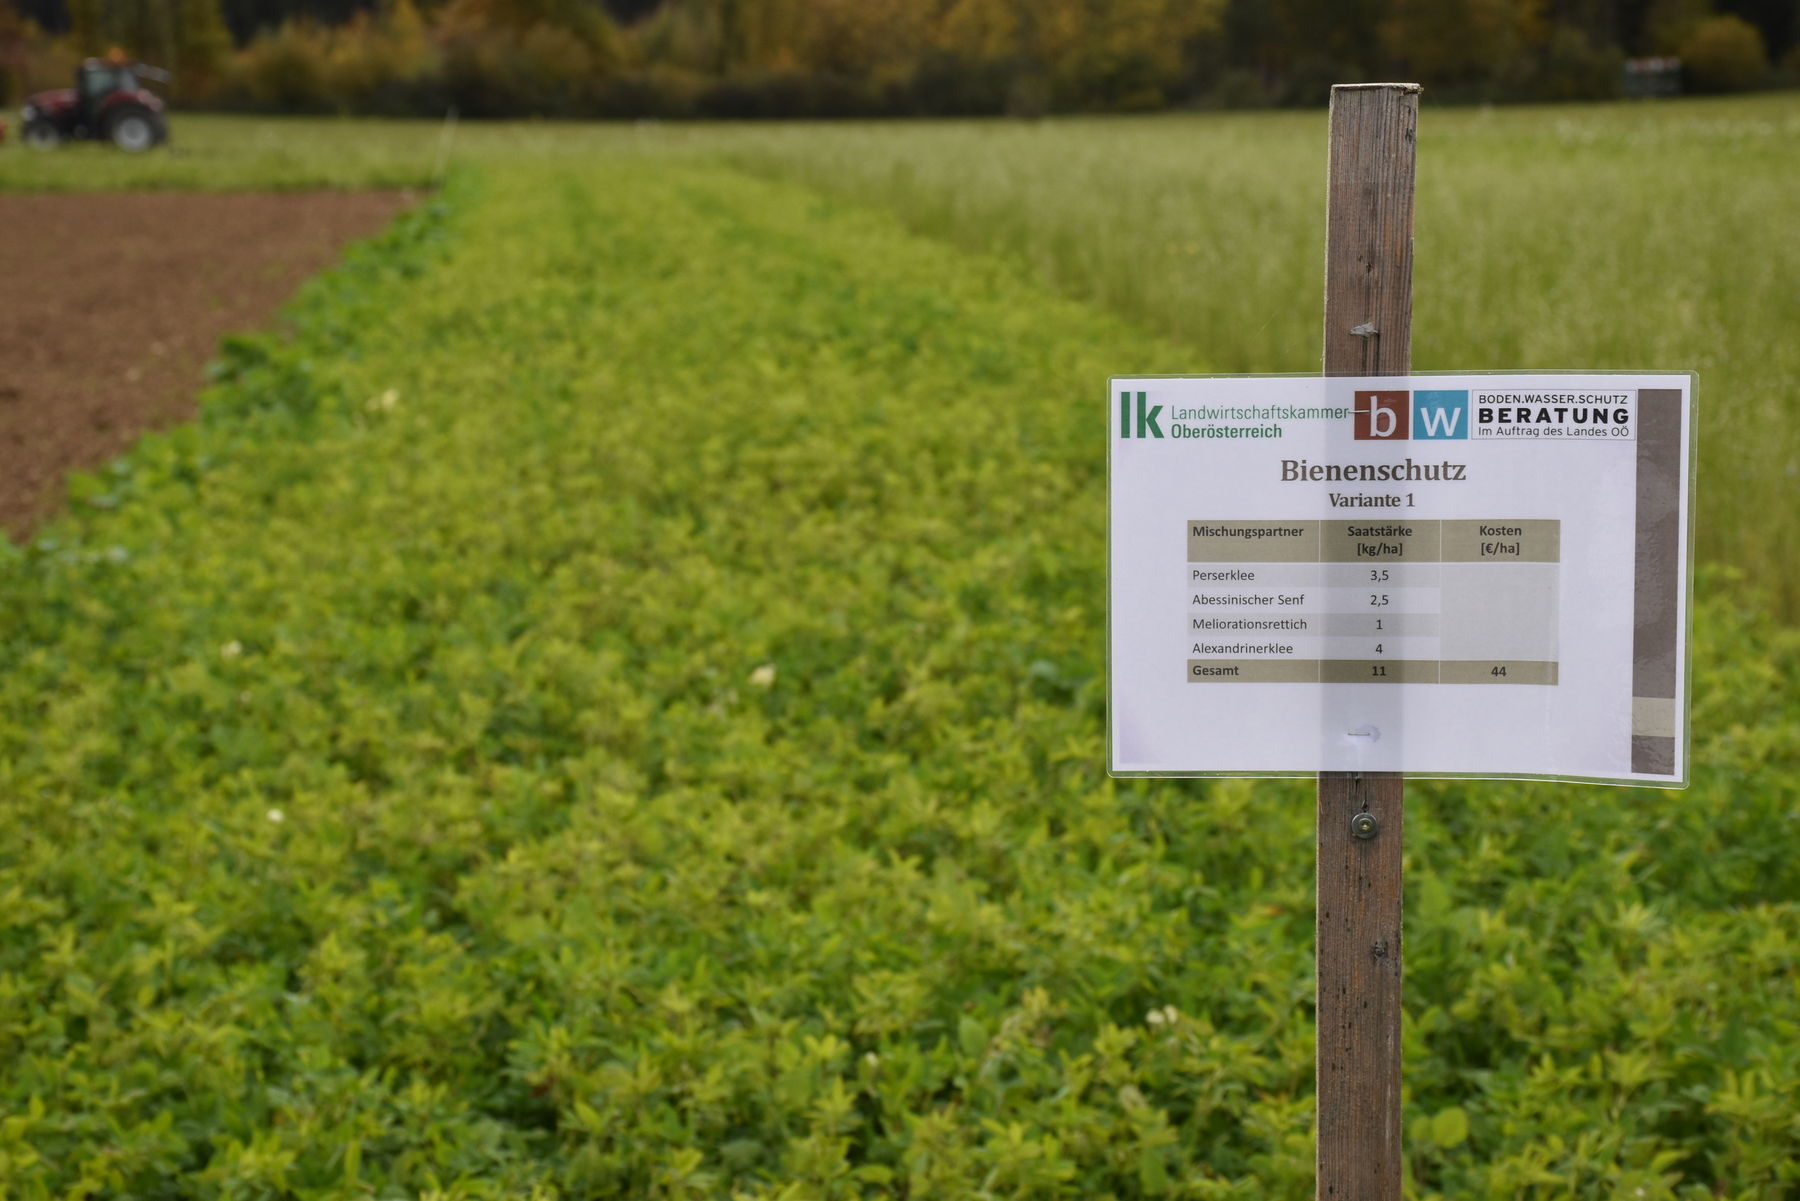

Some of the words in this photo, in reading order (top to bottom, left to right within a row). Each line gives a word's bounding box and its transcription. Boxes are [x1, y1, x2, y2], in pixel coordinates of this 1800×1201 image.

[1478, 394, 1628, 405] BODEN.WASSER.SCHUTZ
[1120, 391, 1165, 439] lk
[1171, 405, 1349, 420] Landwirtschaftskammer
[1478, 407, 1629, 424] BERATUNG
[1171, 424, 1282, 439] Oberösterreich
[1478, 427, 1491, 436] Im
[1496, 426, 1540, 438] Auftrag
[1543, 426, 1563, 436] des
[1567, 426, 1607, 437] Landes
[1611, 425, 1629, 437] OÖ
[1280, 459, 1467, 482] Bienenschutz
[1328, 493, 1401, 507] Variante
[1406, 493, 1416, 507] 1
[1192, 526, 1304, 539] Mischungspartner
[1347, 525, 1412, 537] Saatstärke
[1479, 525, 1522, 536] Kosten
[1357, 543, 1403, 556] [kg/ha]
[1481, 542, 1520, 555] [€/ha]
[1192, 569, 1255, 581] Perserklee
[1370, 570, 1389, 582] 3,5
[1192, 594, 1274, 605] Abessinischer
[1278, 594, 1305, 605] Senf
[1370, 595, 1389, 607] 2,5
[1192, 618, 1308, 630] Meliorationsrettich
[1376, 619, 1383, 630] 1
[1192, 642, 1294, 654] Alexandrinerklee
[1375, 643, 1383, 654] 4
[1192, 665, 1240, 676] Gesamt
[1372, 666, 1387, 676] 11
[1491, 666, 1507, 677] 44
